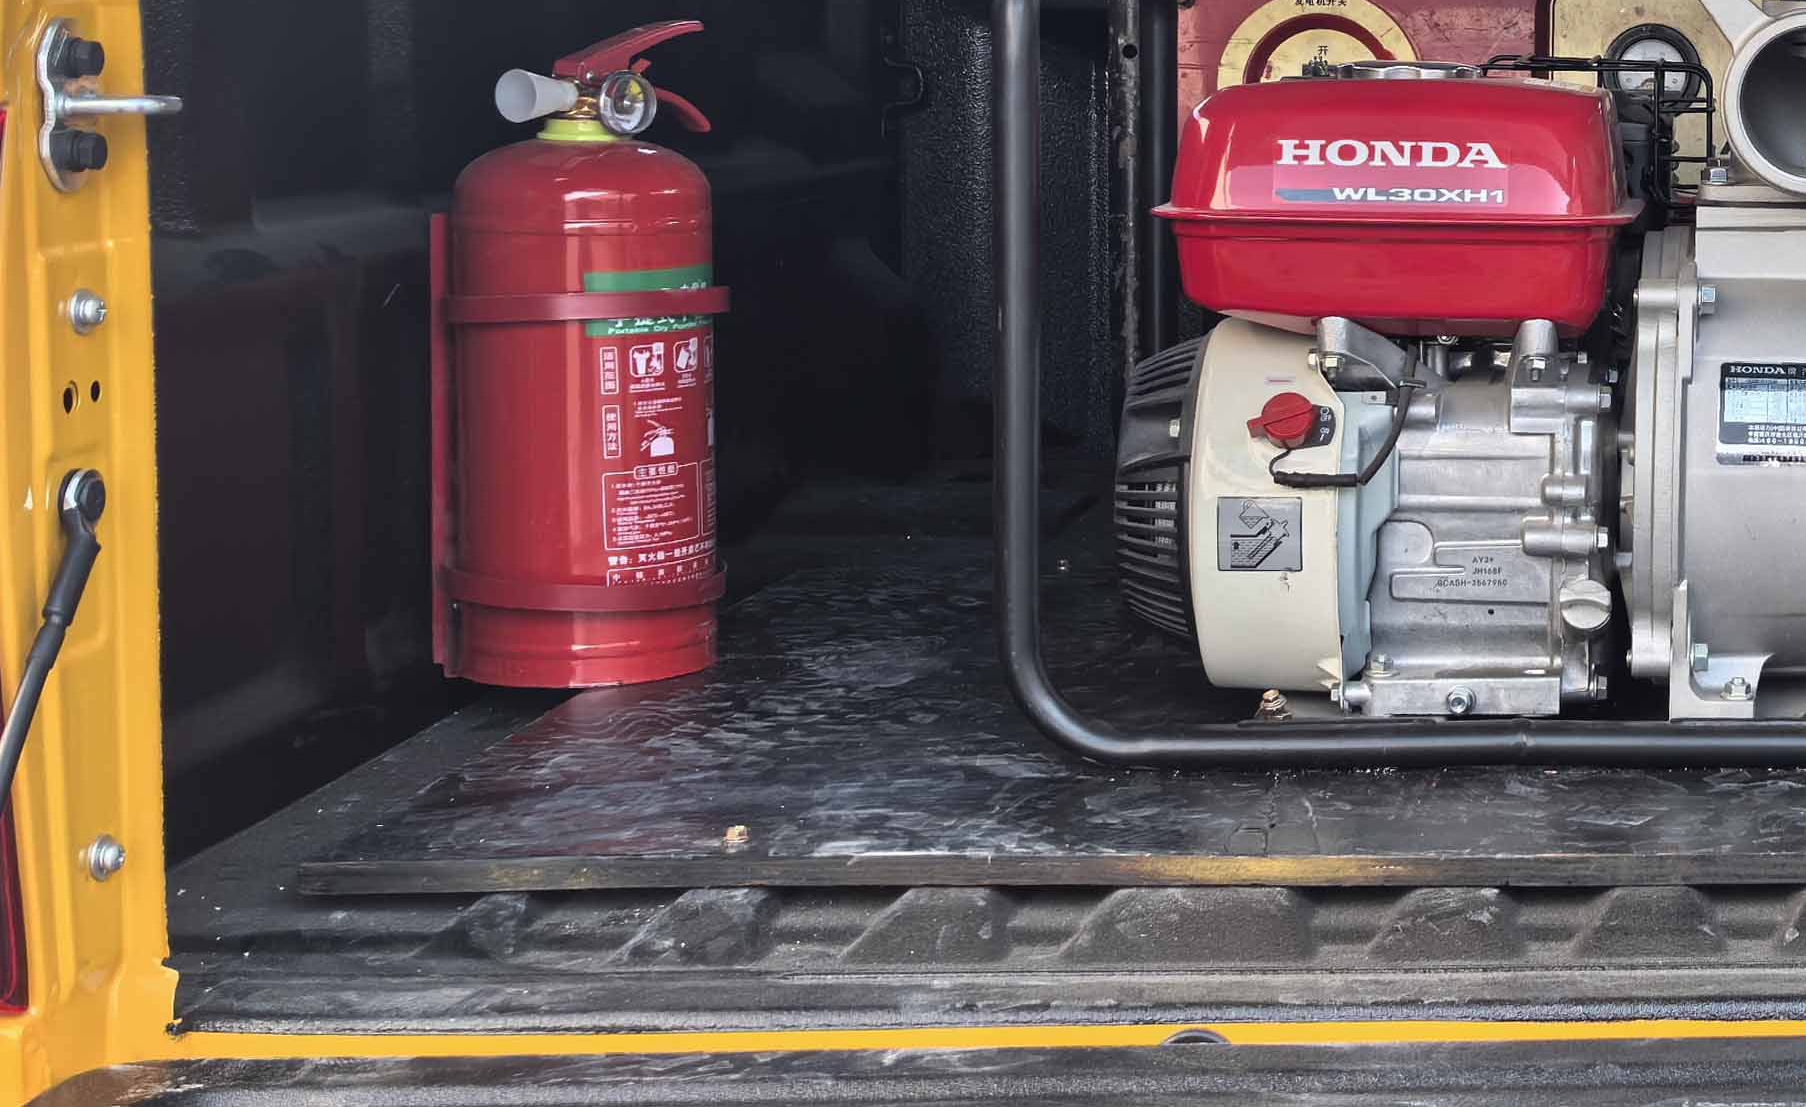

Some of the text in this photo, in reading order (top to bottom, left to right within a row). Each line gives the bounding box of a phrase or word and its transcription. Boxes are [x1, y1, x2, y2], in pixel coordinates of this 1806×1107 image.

[1317, 44, 1329, 57] 开
[1276, 139, 1507, 169] HONDA
[1331, 187, 1505, 203] WL30XH1
[653, 324, 669, 333] Dry
[1730, 365, 1787, 375] HONDA
